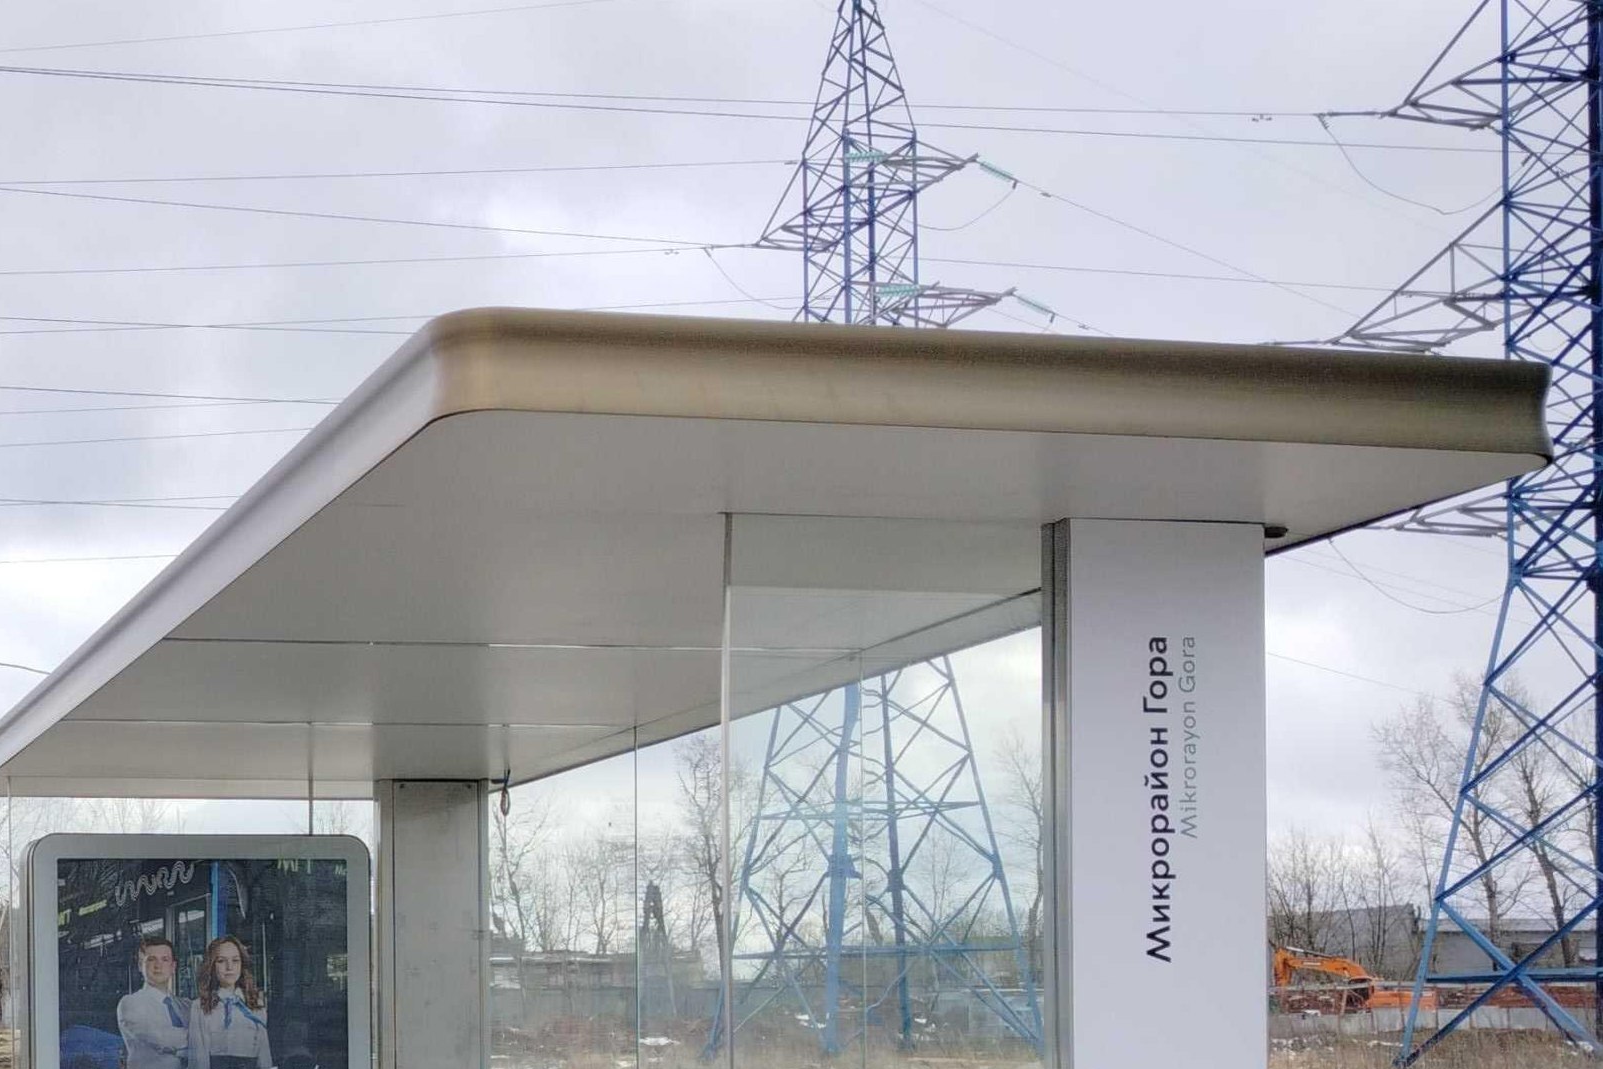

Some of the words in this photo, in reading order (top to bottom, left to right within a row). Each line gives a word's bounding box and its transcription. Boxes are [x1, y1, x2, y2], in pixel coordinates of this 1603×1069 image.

[1143, 636, 1173, 713] Гора
[1178, 636, 1195, 693] Gora
[1180, 701, 1200, 839] Mikrorayon
[1144, 727, 1176, 963] Микрорайон
